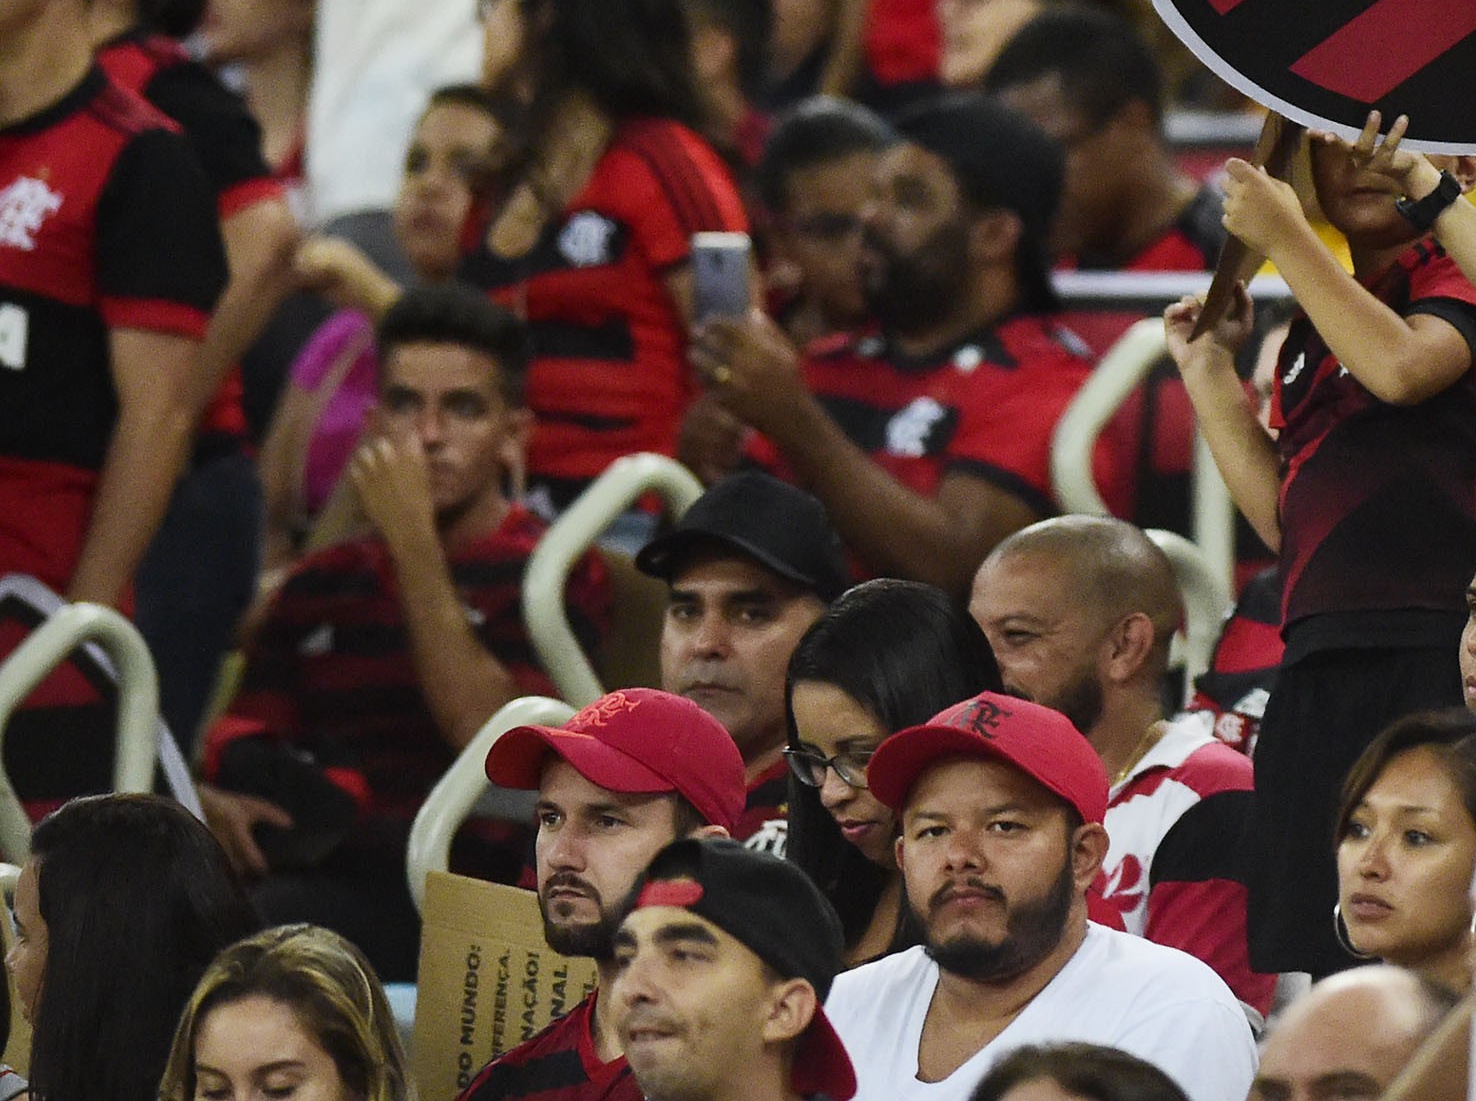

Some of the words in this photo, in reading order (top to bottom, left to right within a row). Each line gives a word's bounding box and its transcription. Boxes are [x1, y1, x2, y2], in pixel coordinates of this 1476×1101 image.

[460, 944, 481, 1045] MUNDO:
[491, 949, 510, 1060] IFERENÇA.
[457, 1052, 473, 1088] DO
